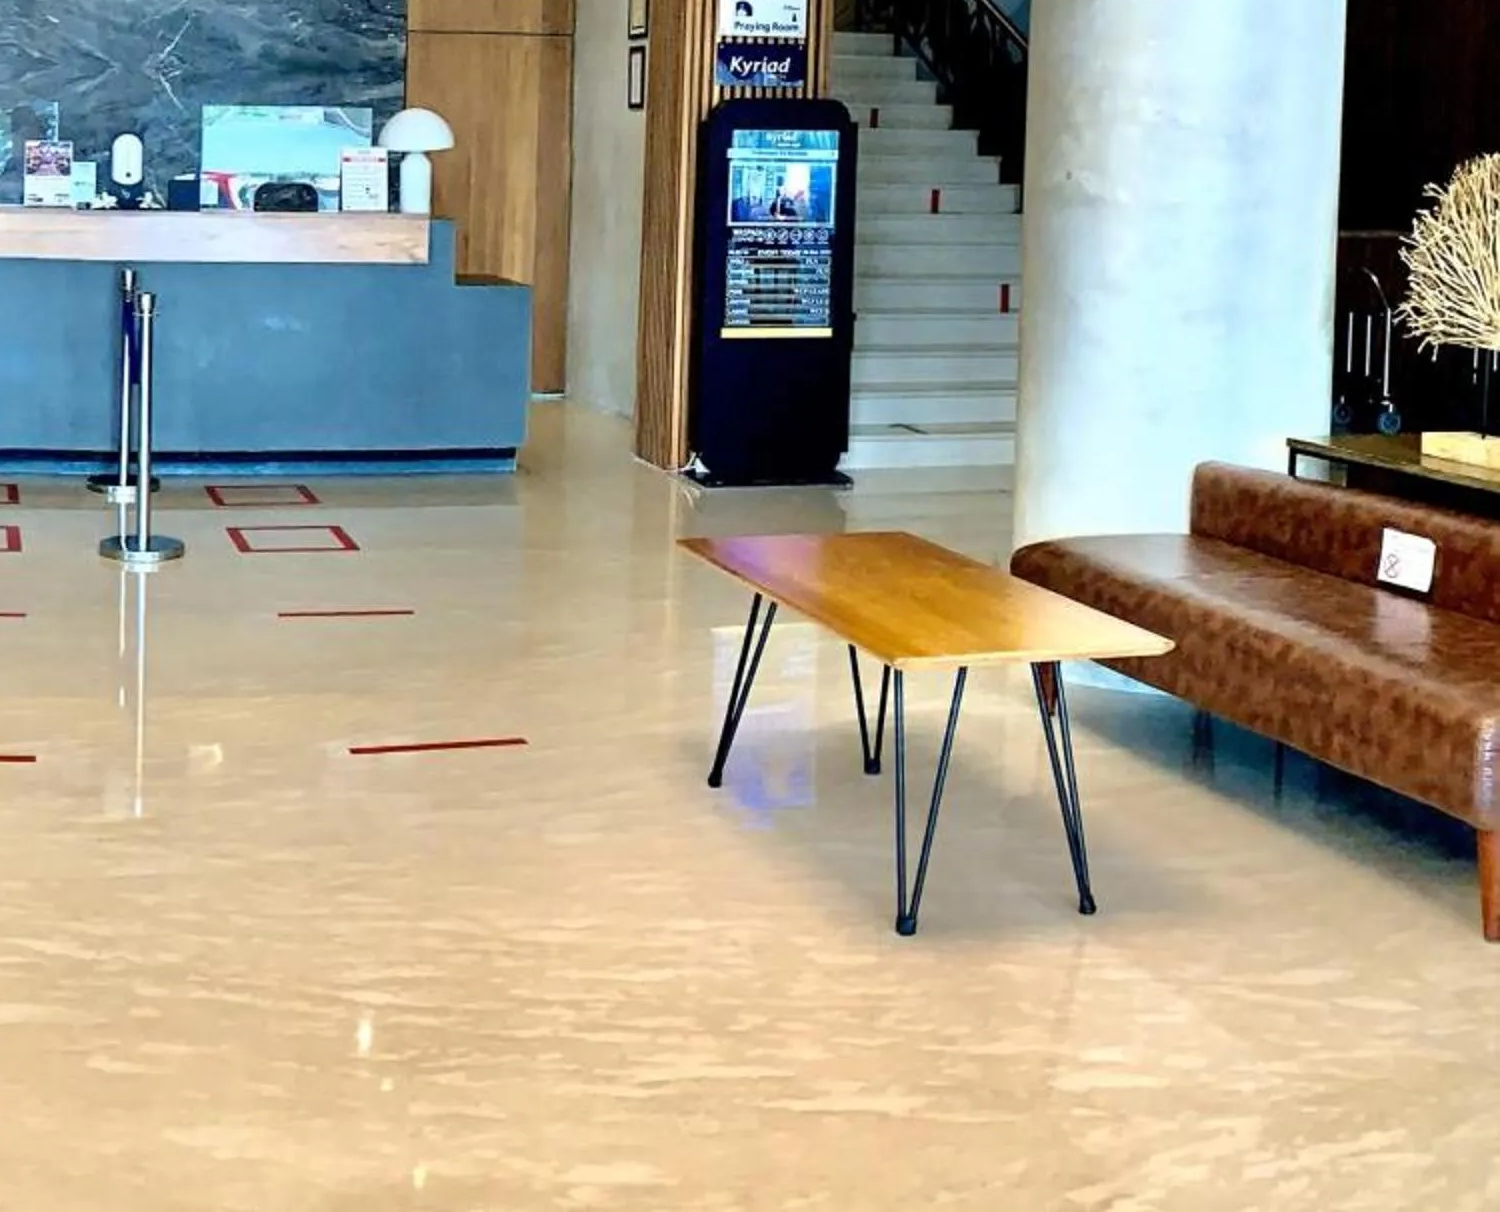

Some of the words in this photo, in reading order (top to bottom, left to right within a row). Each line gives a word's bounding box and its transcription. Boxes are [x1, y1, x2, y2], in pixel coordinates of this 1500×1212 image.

[734, 21, 770, 33] Praying
[772, 22, 799, 31] Room
[730, 56, 791, 76] Kyriad
